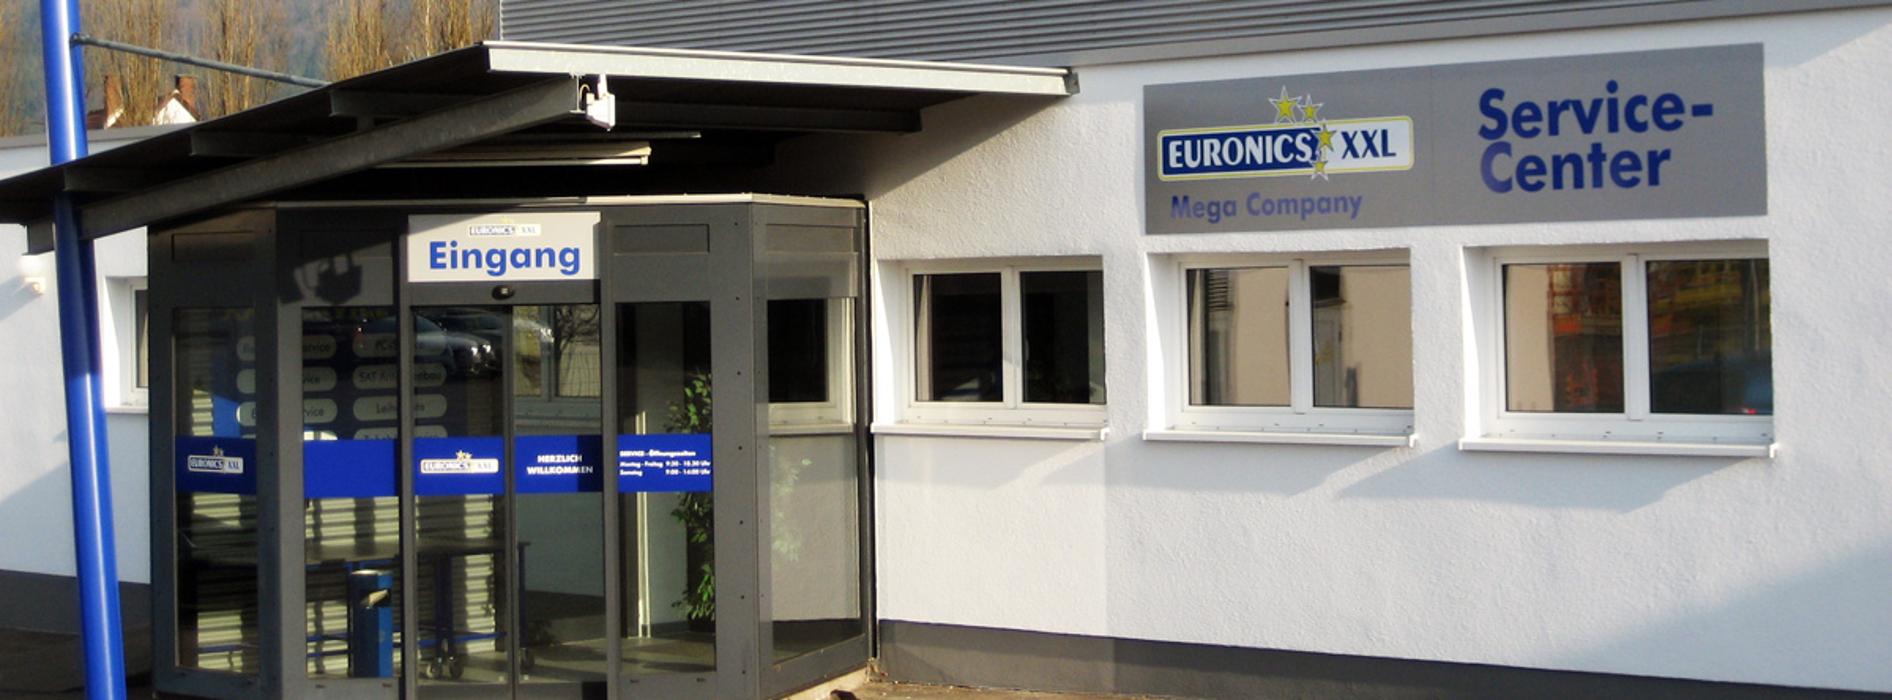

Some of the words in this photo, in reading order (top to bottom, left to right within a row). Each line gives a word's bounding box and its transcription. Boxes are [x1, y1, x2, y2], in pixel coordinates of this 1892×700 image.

[1478, 80, 1714, 140] Service-
[1168, 133, 1313, 168] EURONICS
[1342, 129, 1396, 159] XXL
[1480, 142, 1672, 194] Center
[1170, 195, 1237, 223] Mega
[1247, 192, 1363, 220] Company
[429, 240, 581, 277] Eingang
[526, 465, 594, 475] WILLKOMMEN
[537, 454, 583, 464] HERZLICH
